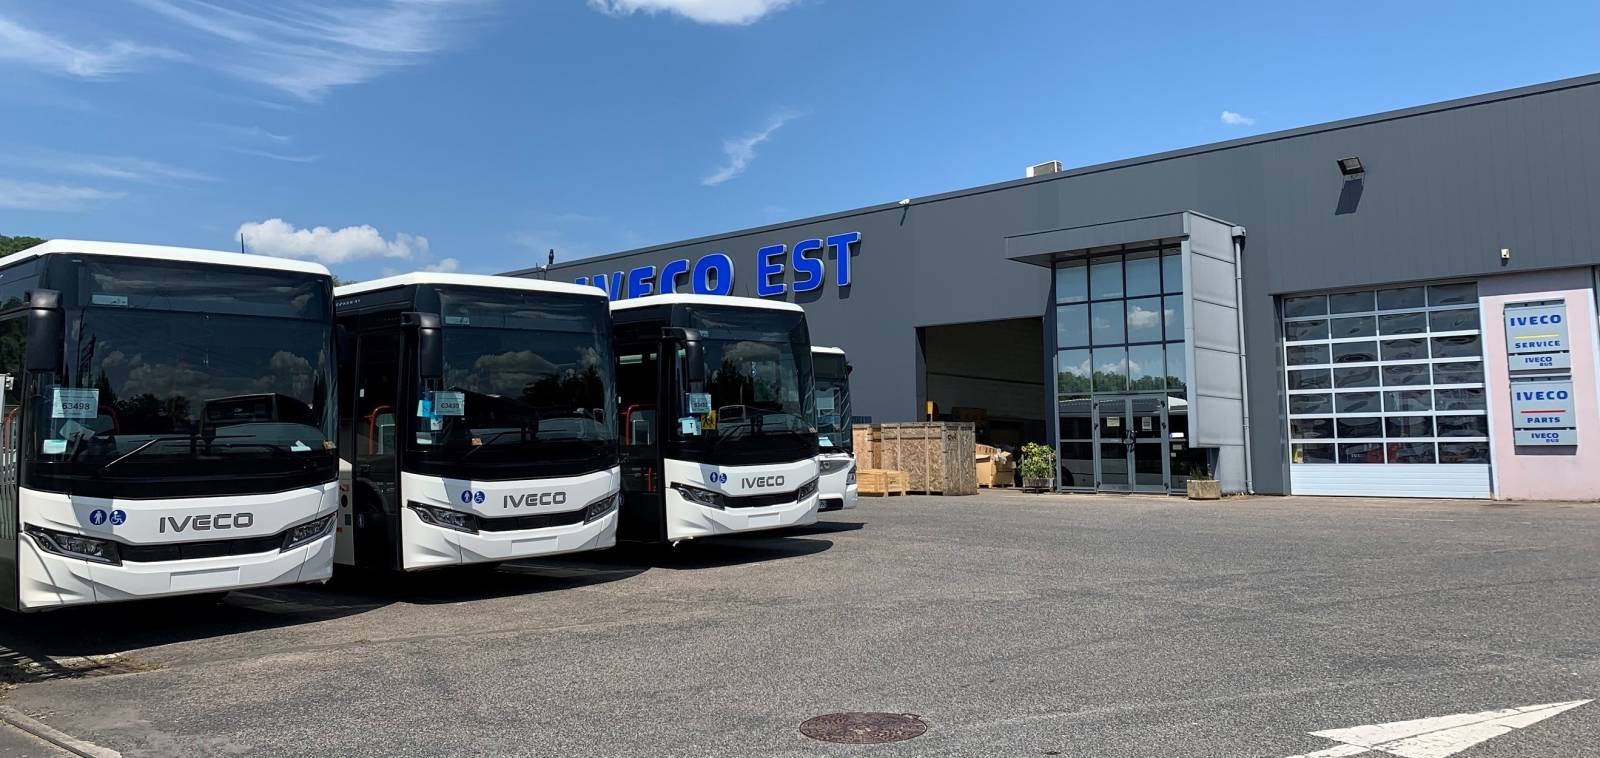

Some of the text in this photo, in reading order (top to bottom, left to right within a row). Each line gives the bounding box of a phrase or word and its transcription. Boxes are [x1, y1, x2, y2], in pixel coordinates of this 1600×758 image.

[575, 231, 862, 301] VECO EST
[1510, 314, 1562, 327] IVECO
[1515, 340, 1561, 349] SERVICE
[1516, 390, 1568, 401] IVECO
[1527, 416, 1561, 424] PARTS
[741, 475, 785, 489] IVECO
[503, 491, 567, 508] IVECO
[159, 512, 254, 534] IVECO
